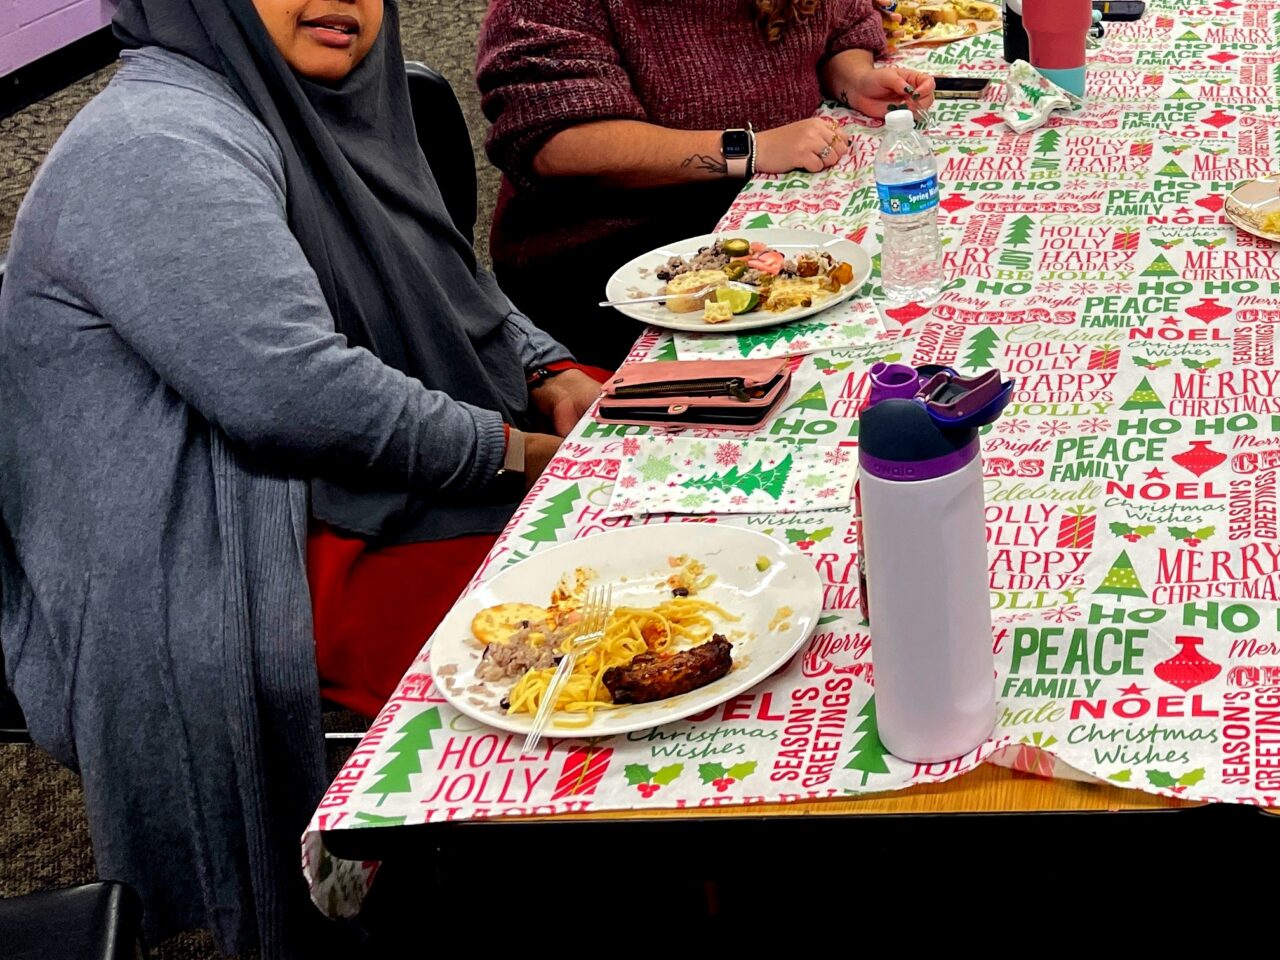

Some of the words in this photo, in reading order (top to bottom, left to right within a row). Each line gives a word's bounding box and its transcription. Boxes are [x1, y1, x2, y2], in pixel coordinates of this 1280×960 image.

[945, 157, 1029, 170] MERRY
[1194, 154, 1274, 170] MERRY
[954, 181, 1003, 191] HO
[1012, 181, 1061, 191] HO
[1108, 190, 1190, 204] PEACE
[1106, 205, 1163, 216] FAMILY
[1147, 215, 1236, 226] NOEL
[1040, 226, 1112, 238] HOLLY
[1040, 239, 1106, 250] JOLLY
[1040, 251, 1136, 264] HAPPY
[1184, 251, 1276, 270] MERRY
[1182, 266, 1280, 281] CHRISTMAS
[976, 280, 1032, 295] HO
[1139, 282, 1192, 294] HO
[1205, 281, 1258, 293] HO
[1085, 297, 1177, 313] PEACE
[1082, 316, 1145, 327] FAMILY
[1129, 327, 1230, 340] NOEL
[1005, 342, 1084, 357] HOLLY
[1008, 356, 1079, 373] JOLLY
[1174, 369, 1280, 399] MERRY
[1004, 403, 1115, 416] JOLLY
[1118, 418, 1181, 435] HO
[1196, 414, 1257, 434] HO
[983, 438, 1052, 456] Bright
[1055, 436, 1166, 463] PEACE
[1051, 461, 1127, 481] FAMILY
[1106, 481, 1228, 499] NOEL
[1103, 498, 1226, 512] Christmas
[1229, 480, 1251, 540] SEASON'S
[1254, 471, 1277, 539] GREETINGS
[1125, 509, 1204, 523] Wishes
[1089, 604, 1166, 624] HO
[1184, 602, 1259, 633] HO
[1011, 628, 1148, 675] PEACE
[1003, 678, 1099, 698] FAMILY
[1069, 696, 1221, 720] NOEL
[627, 726, 778, 743] Christmas
[770, 687, 820, 782] SEASON'S
[801, 678, 853, 789] GREETINGS
[1068, 725, 1217, 743] Christmas
[1222, 692, 1251, 784] SEASON'S
[651, 742, 745, 759] Wishes
[1095, 745, 1187, 764] Wishes
[420, 767, 549, 804] JOLLY
